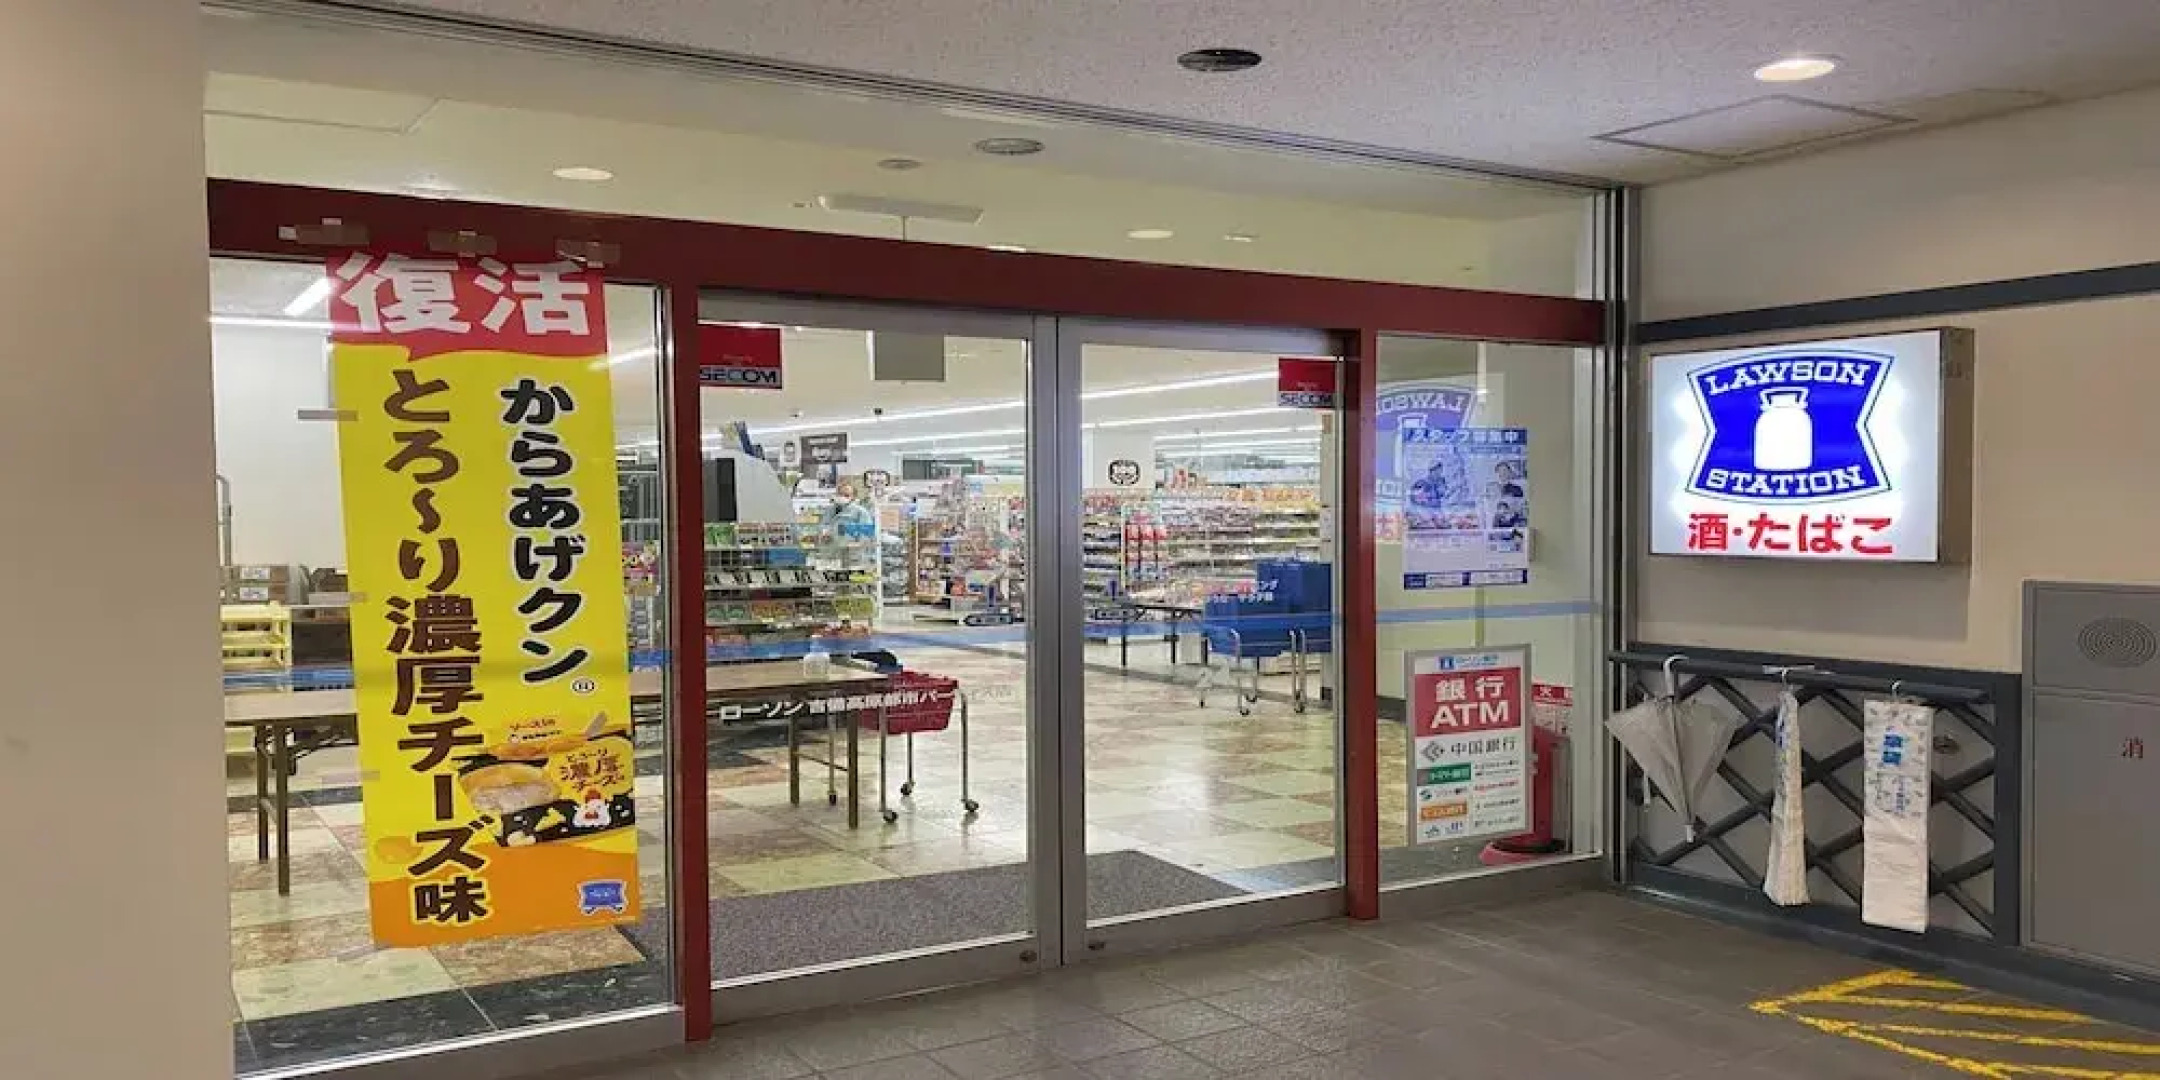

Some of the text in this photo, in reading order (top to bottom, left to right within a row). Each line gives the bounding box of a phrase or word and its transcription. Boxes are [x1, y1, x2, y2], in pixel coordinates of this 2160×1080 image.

[338, 253, 591, 335] 復活
[700, 367, 776, 382] SECOM
[1705, 361, 1870, 395] LAWSON
[1705, 466, 1865, 495] STATION
[1688, 512, 1892, 553] 酒・たばこ
[1436, 676, 1504, 702] 銀行
[720, 702, 803, 720] ローソン
[1431, 700, 1509, 728] ATM
